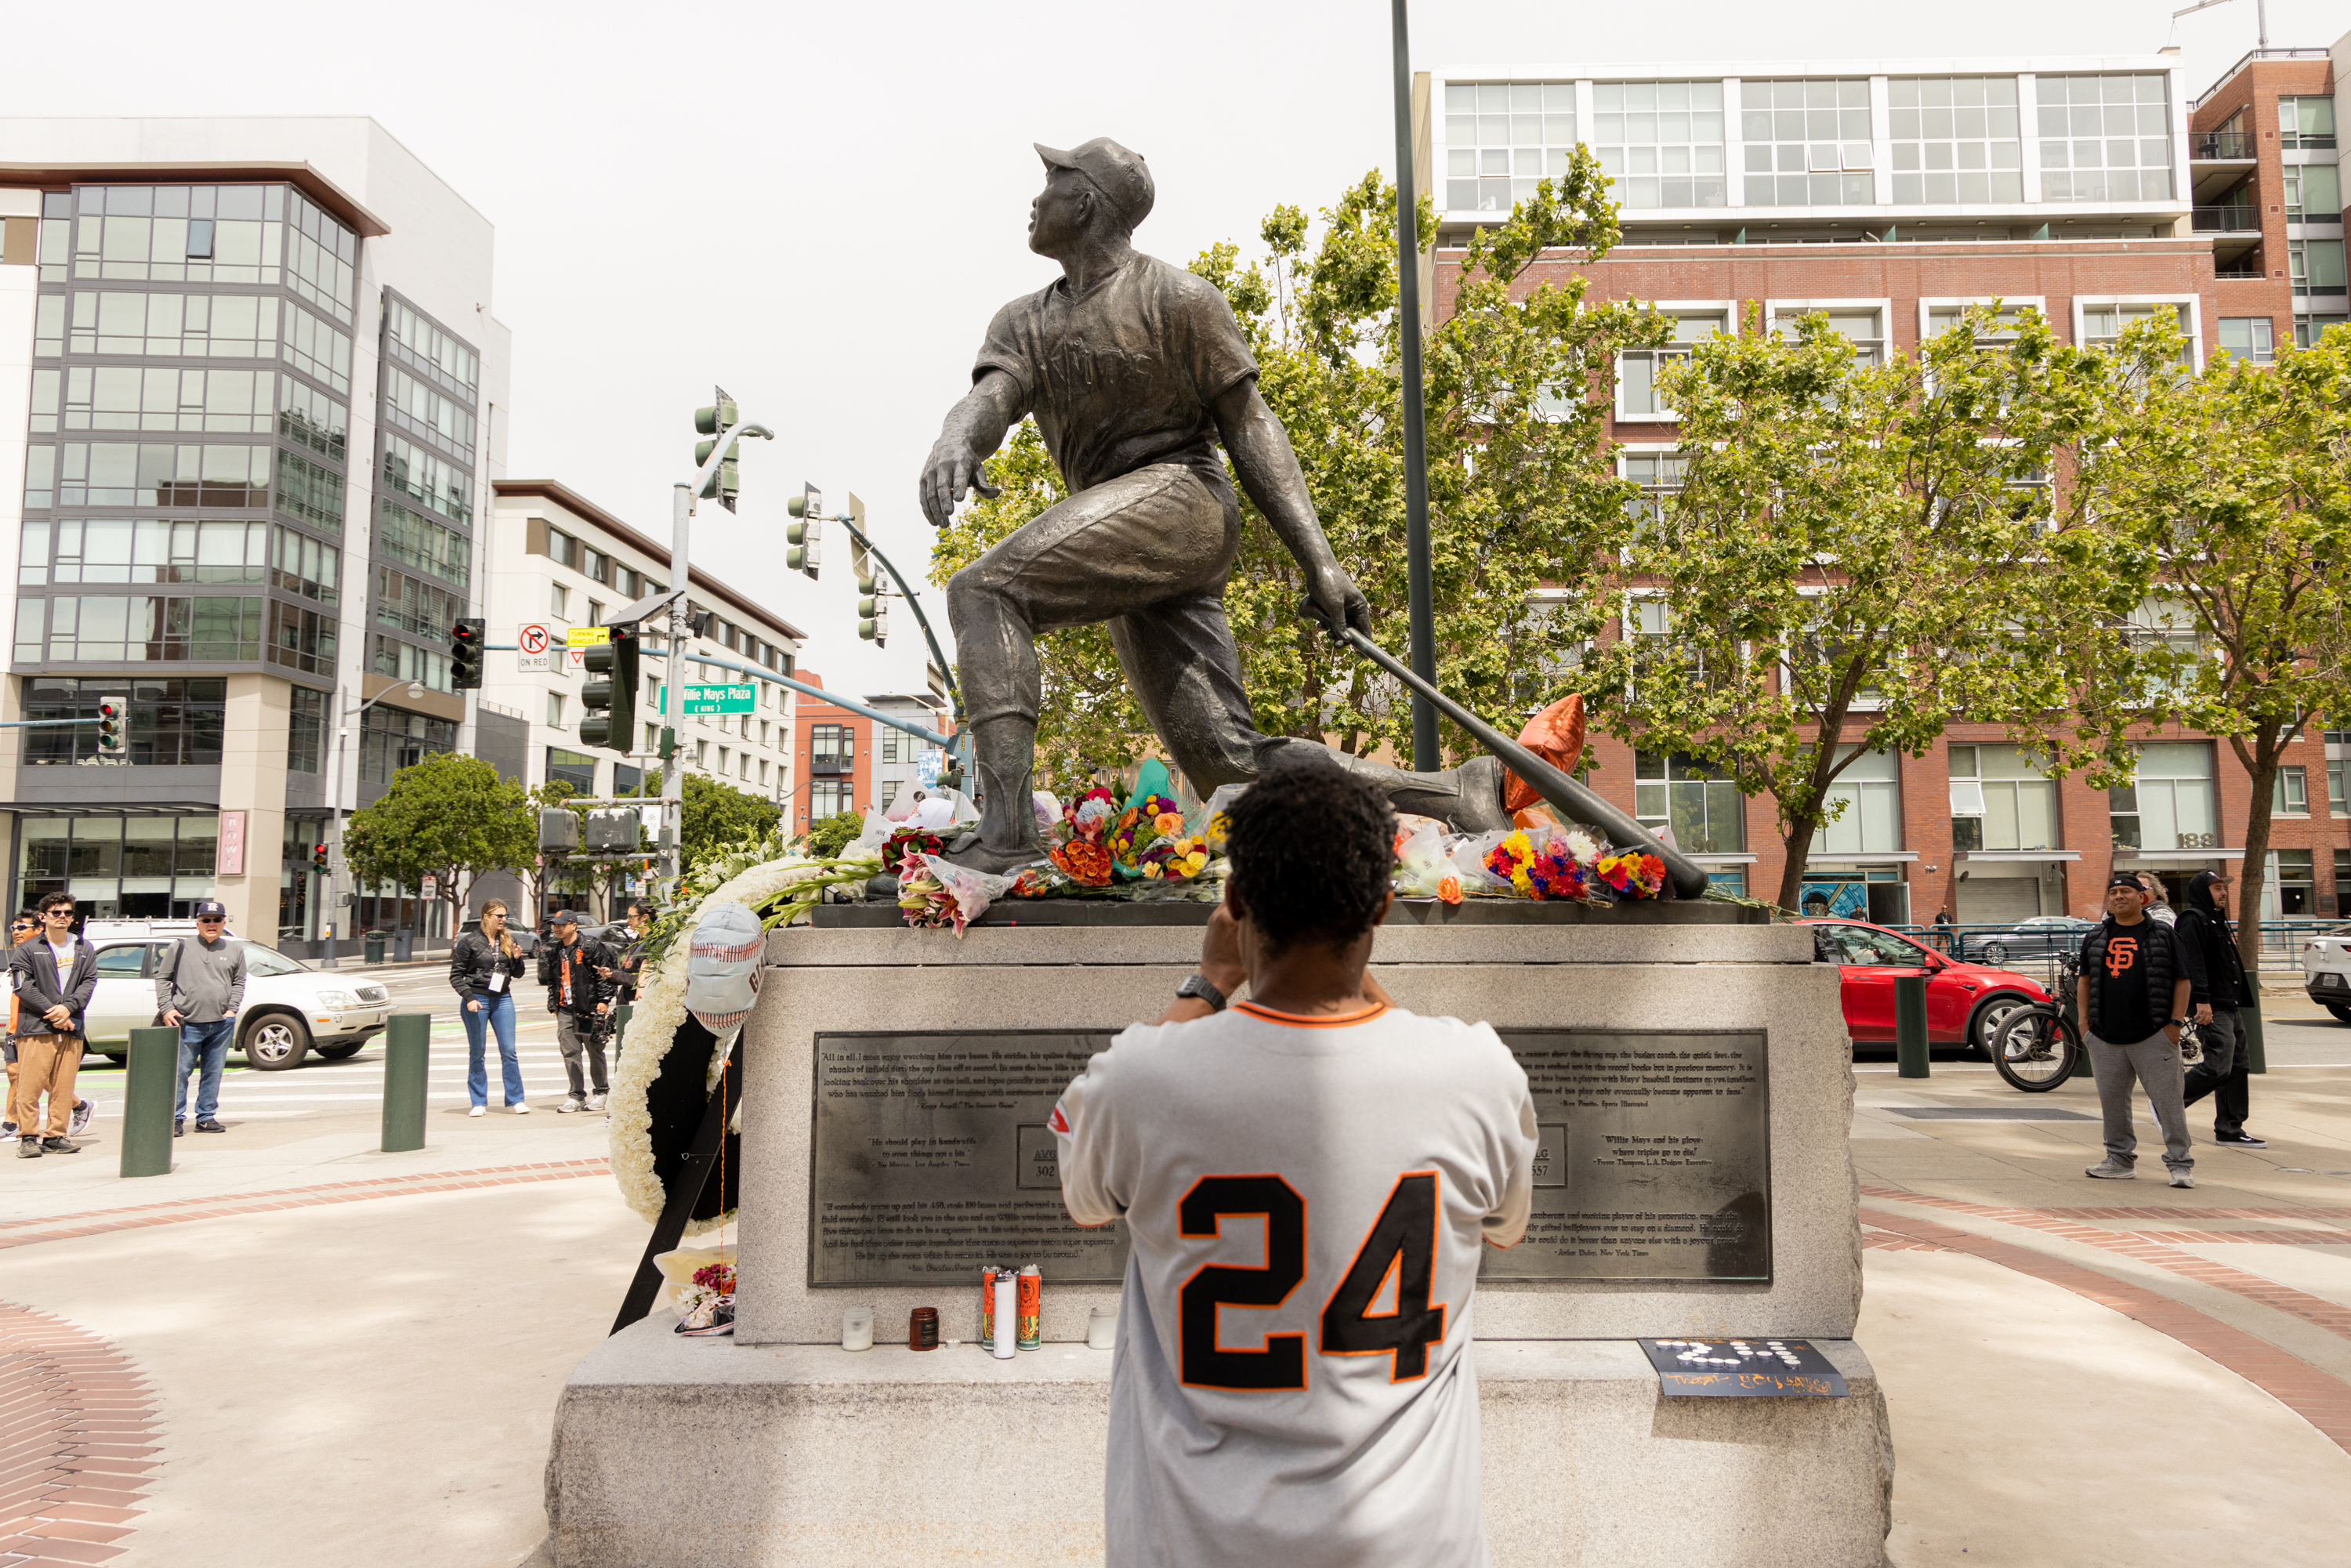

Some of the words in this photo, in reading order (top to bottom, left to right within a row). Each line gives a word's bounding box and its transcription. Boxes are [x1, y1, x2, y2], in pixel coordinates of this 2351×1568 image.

[703, 688, 726, 703] Mays
[728, 687, 751, 700] Plaza
[225, 817, 237, 867] BOWL
[1681, 838, 1719, 853] 190
[2176, 833, 2215, 849] 188
[1034, 1150, 1056, 1158] AVG
[1535, 1149, 1549, 1157] LG
[1177, 1170, 1447, 1392] 24
[1738, 1374, 1783, 1389] you
